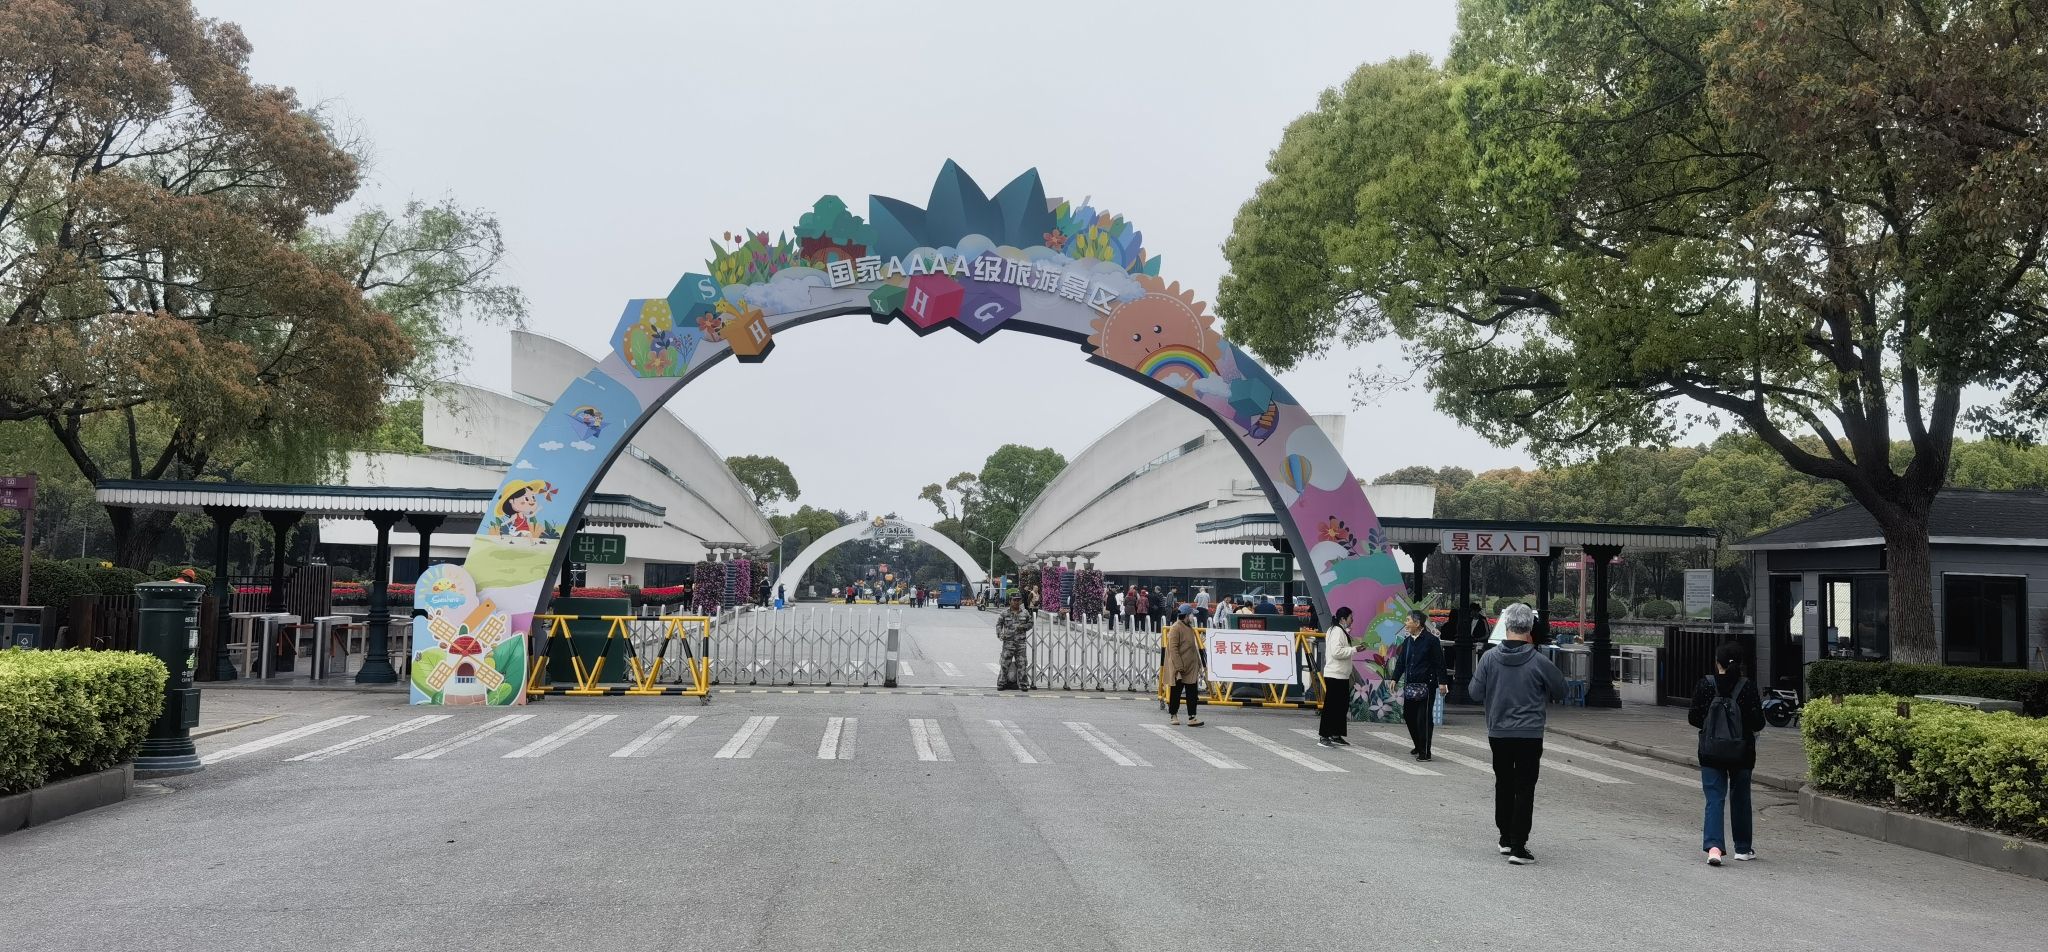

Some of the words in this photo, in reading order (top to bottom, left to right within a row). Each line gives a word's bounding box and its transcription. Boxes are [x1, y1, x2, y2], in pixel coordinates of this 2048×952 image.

[698, 278, 716, 300] S
[827, 253, 1119, 316] 国家AAAA级旅游景区
[873, 299, 885, 312] X
[911, 287, 929, 318] H
[974, 302, 1003, 322] G
[749, 320, 767, 344] H
[579, 536, 618, 553] 出口
[1452, 533, 1540, 552] 景区入口
[585, 554, 610, 562] EXIT
[1250, 555, 1286, 571] 进口
[1251, 572, 1284, 580] ENTRY
[1214, 640, 1289, 656] 景区检票口
